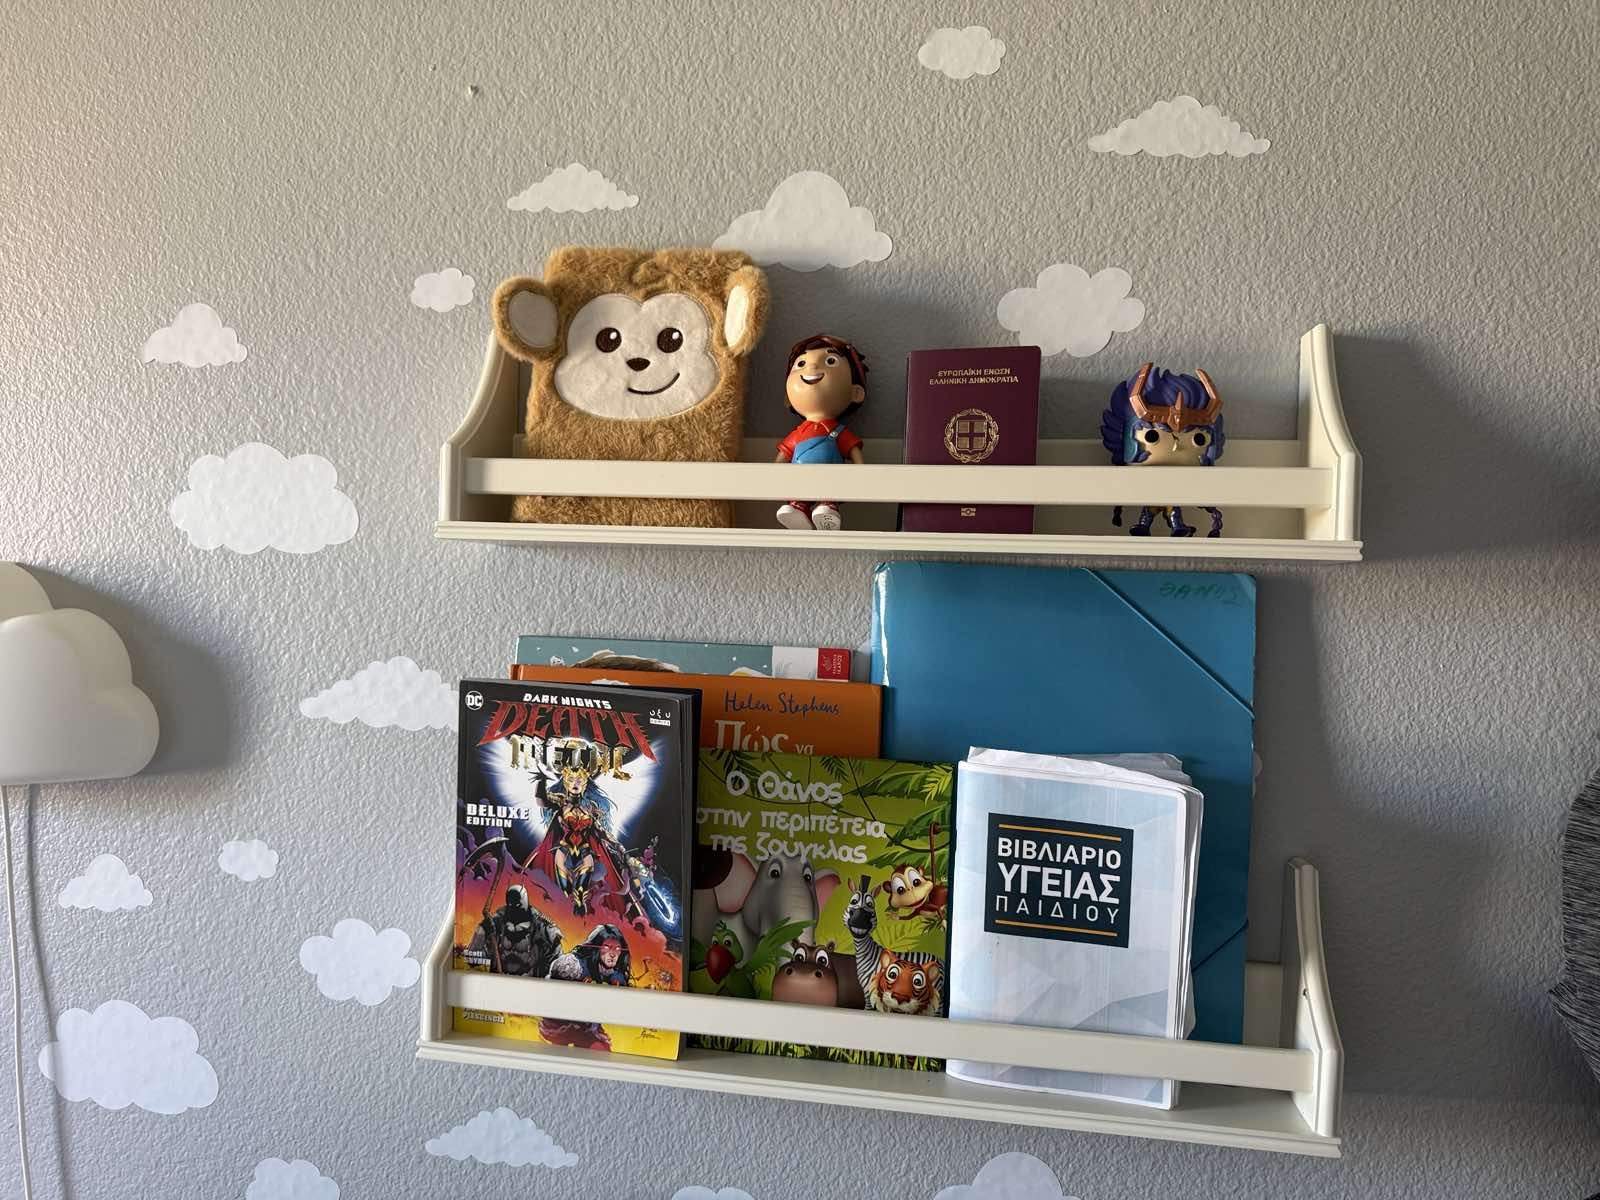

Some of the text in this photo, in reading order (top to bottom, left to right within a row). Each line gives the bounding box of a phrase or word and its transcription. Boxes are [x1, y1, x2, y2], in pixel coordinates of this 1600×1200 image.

[929, 376, 1019, 385] ΕΛΛΗΝΙΚΗ ΔΗΜΟΚΡΑΤΙΑ
[983, 368, 1011, 376] ΕΝΩΣΗ
[466, 693, 483, 708] DC
[522, 693, 612, 710] DARK NIGHTS
[723, 688, 840, 720] Helen Stephens
[477, 700, 658, 762] DEATH
[714, 720, 815, 755] Πώς να
[509, 733, 633, 781] METAL
[726, 770, 844, 804] Ο Θάνος
[466, 803, 530, 819] DELUXE
[466, 816, 512, 828] EDITION
[696, 807, 886, 839] στην περιπέτεια
[710, 834, 748, 854] της
[998, 837, 1121, 869] ΒΙΒΛΙΑΡΙΟ
[998, 862, 1121, 905] ΥΓΕΙΑΣ
[995, 895, 1119, 924] ΠΑΙΔΙΟΥ
